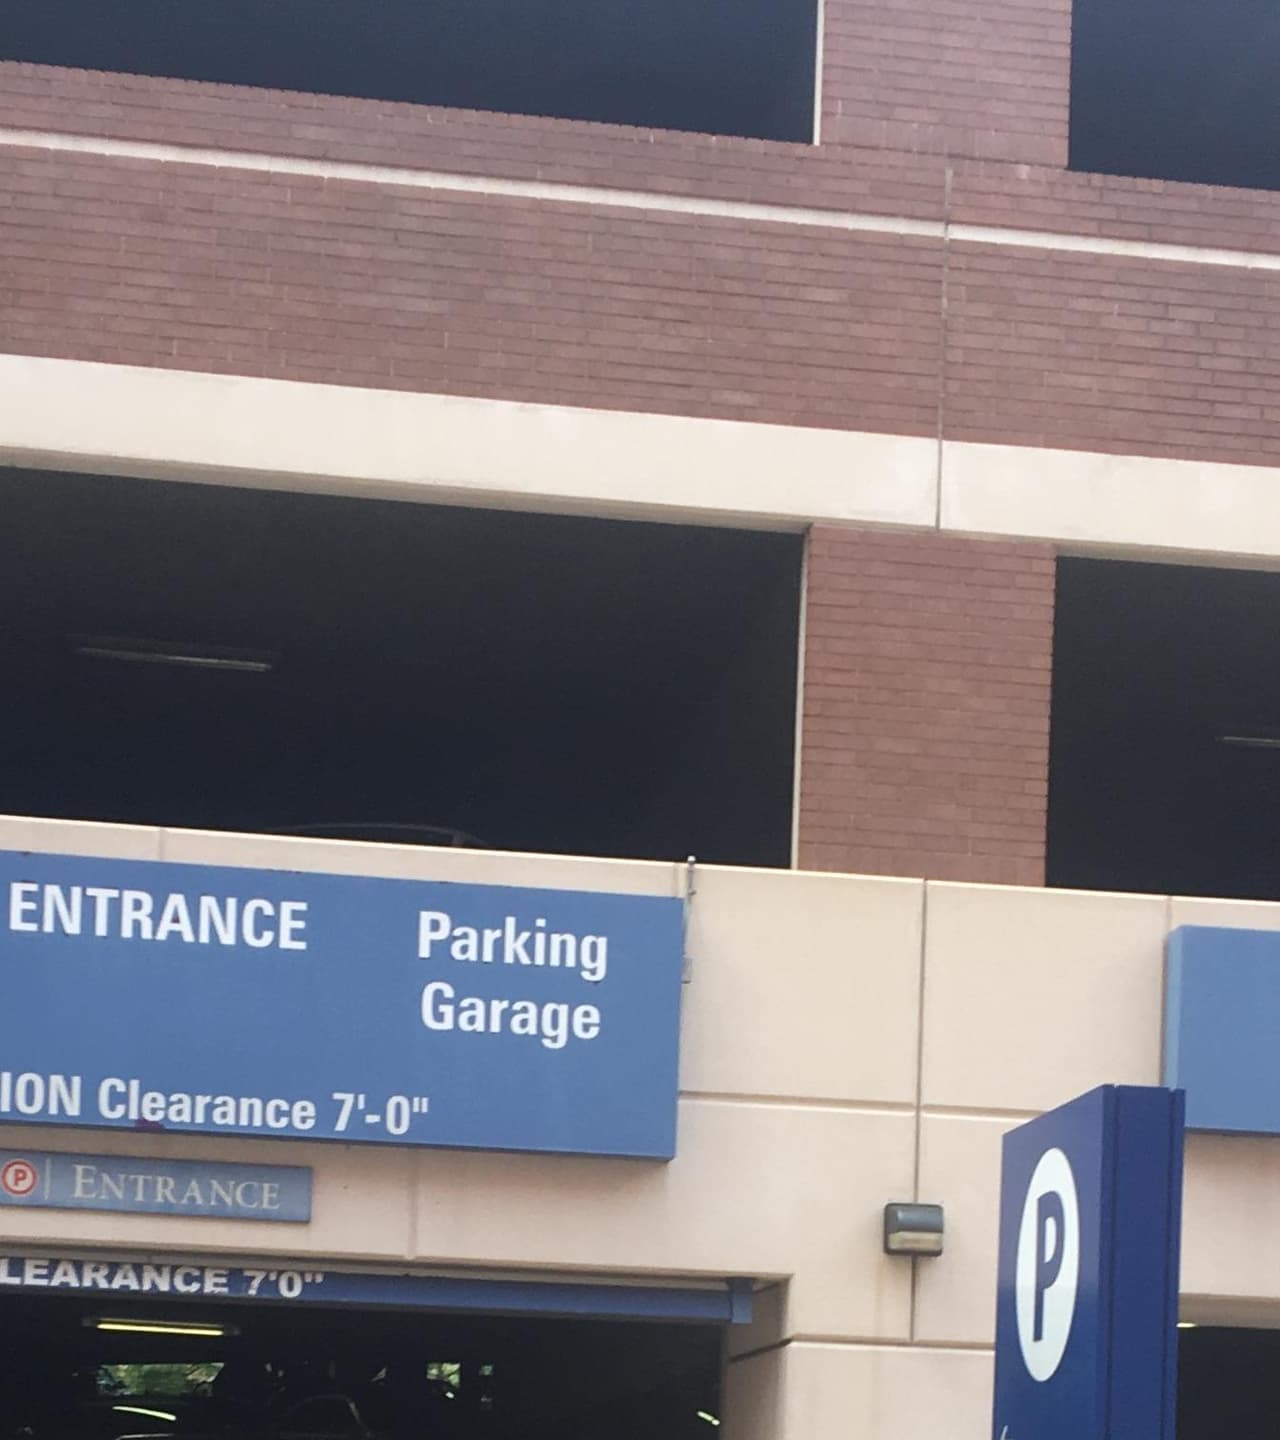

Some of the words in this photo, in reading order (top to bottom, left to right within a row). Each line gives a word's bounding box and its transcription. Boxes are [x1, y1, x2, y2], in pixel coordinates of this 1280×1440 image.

[8, 881, 309, 950] ENTRANCE
[417, 910, 609, 982] Parking
[420, 982, 601, 1049] Garage
[98, 1077, 317, 1132] Clearance
[332, 1093, 430, 1136] 7'-0"
[71, 1164, 282, 1211] ENTRANCE
